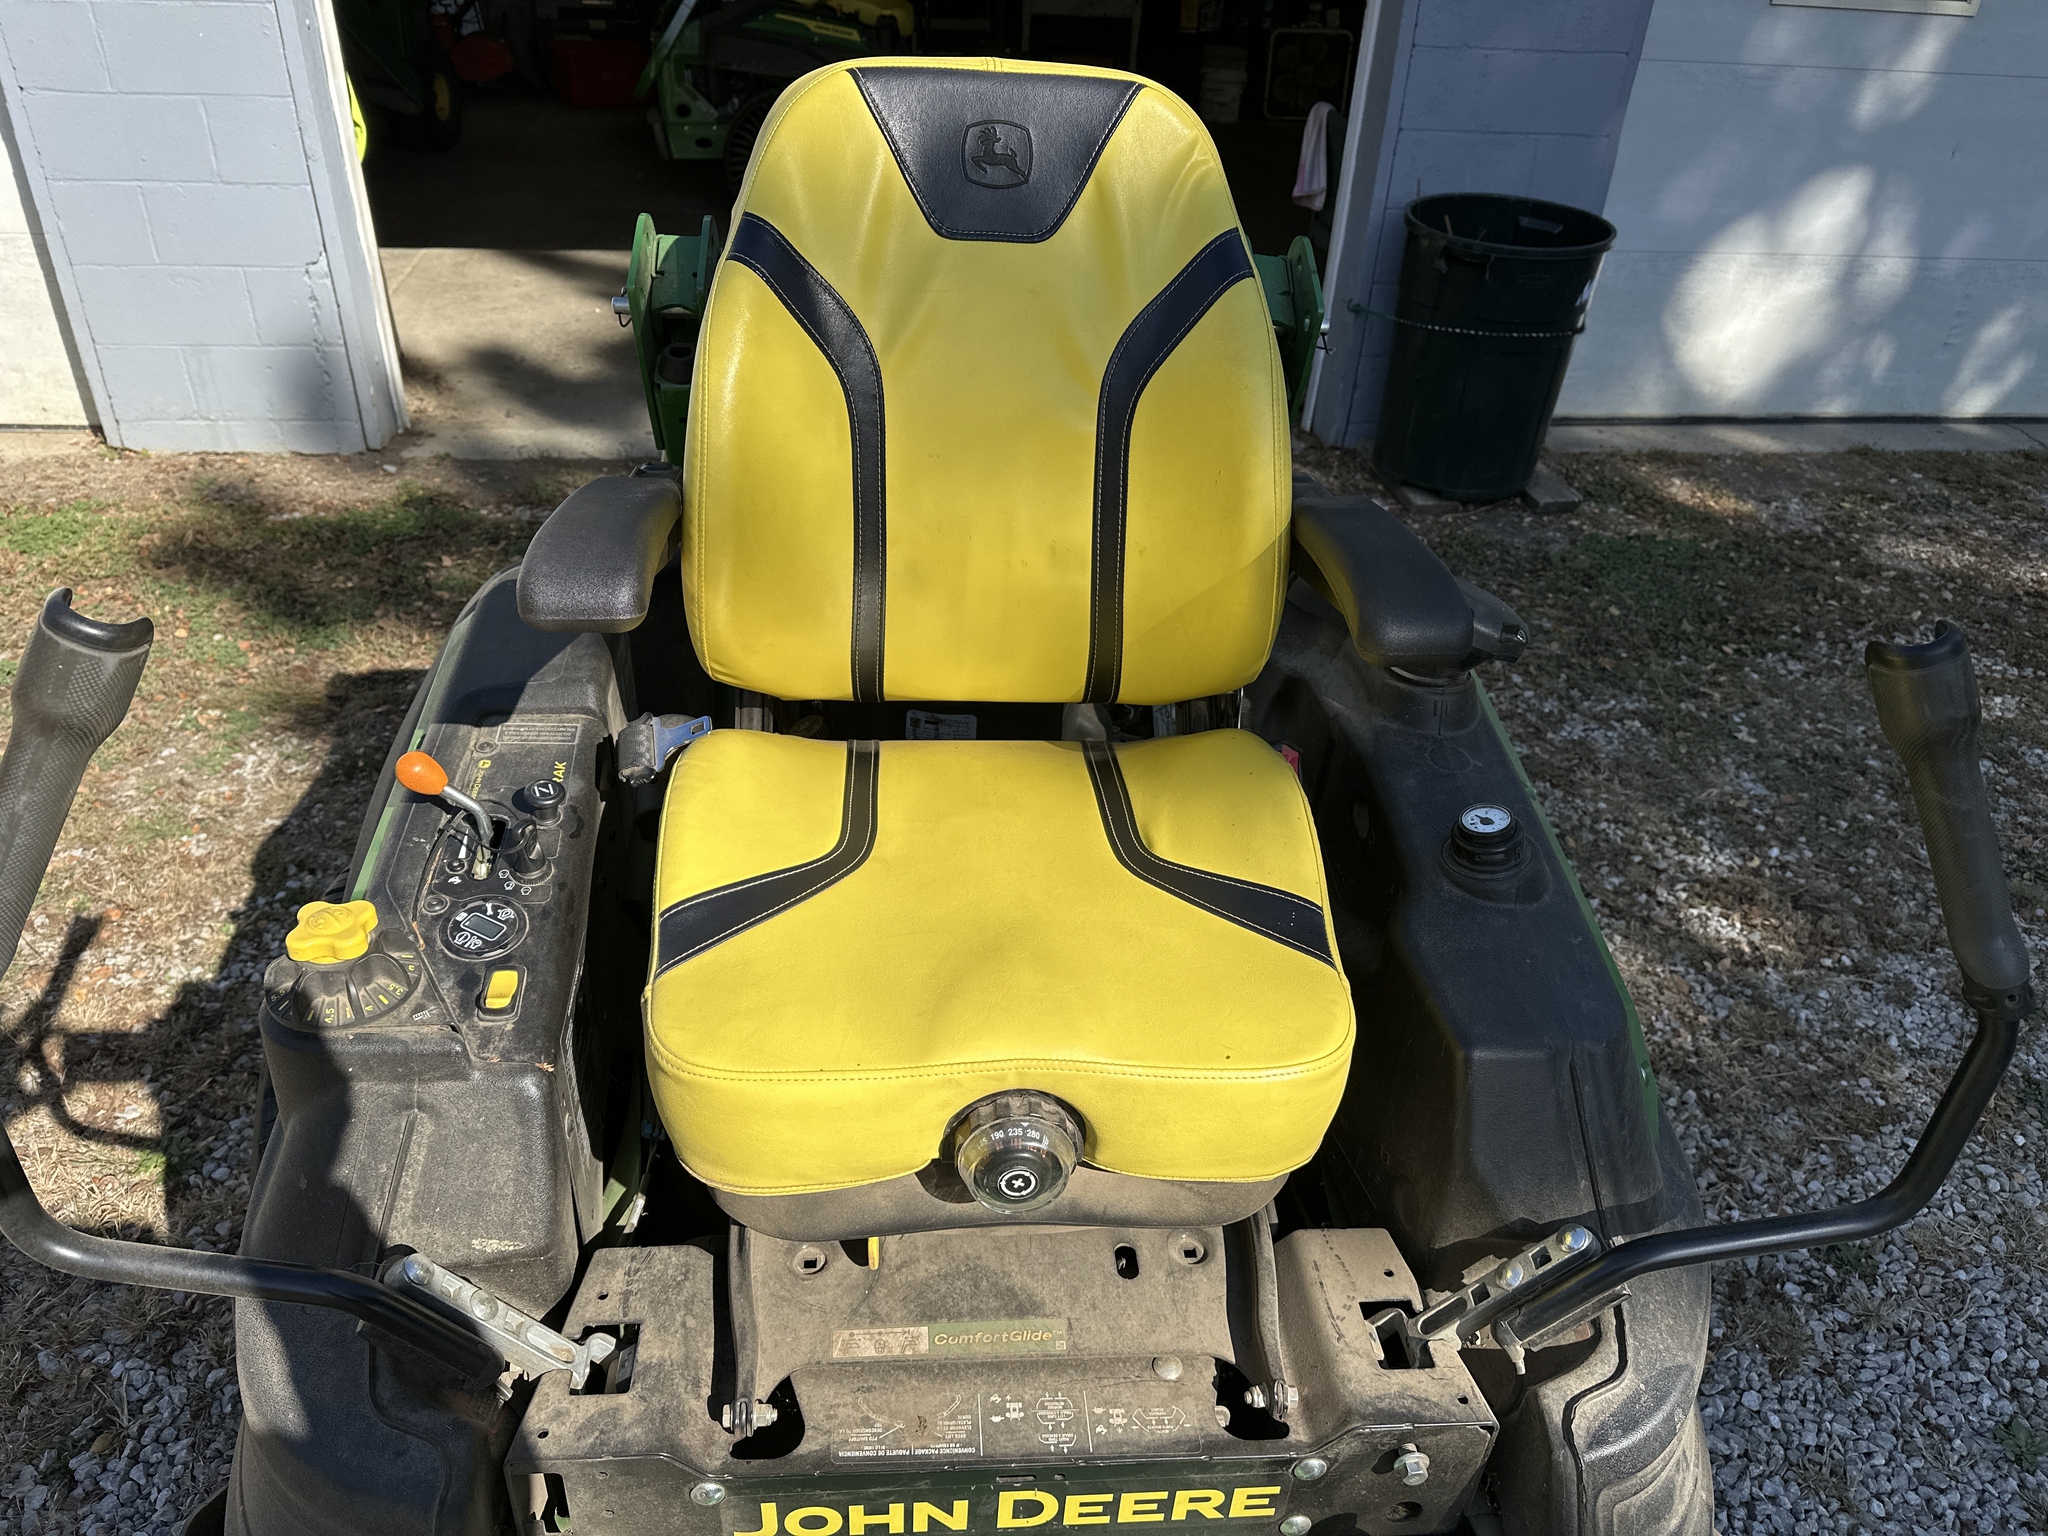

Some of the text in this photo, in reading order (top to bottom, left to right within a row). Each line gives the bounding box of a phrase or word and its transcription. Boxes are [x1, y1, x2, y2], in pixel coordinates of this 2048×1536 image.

[552, 760, 567, 783] RAK
[270, 988, 286, 1002] 5.5
[388, 983, 404, 996] 3.5
[990, 1129, 1005, 1141] 190
[1007, 1127, 1023, 1136] 235
[1026, 1128, 1040, 1140] 280
[733, 1486, 1282, 1536] JOHN DEERE
